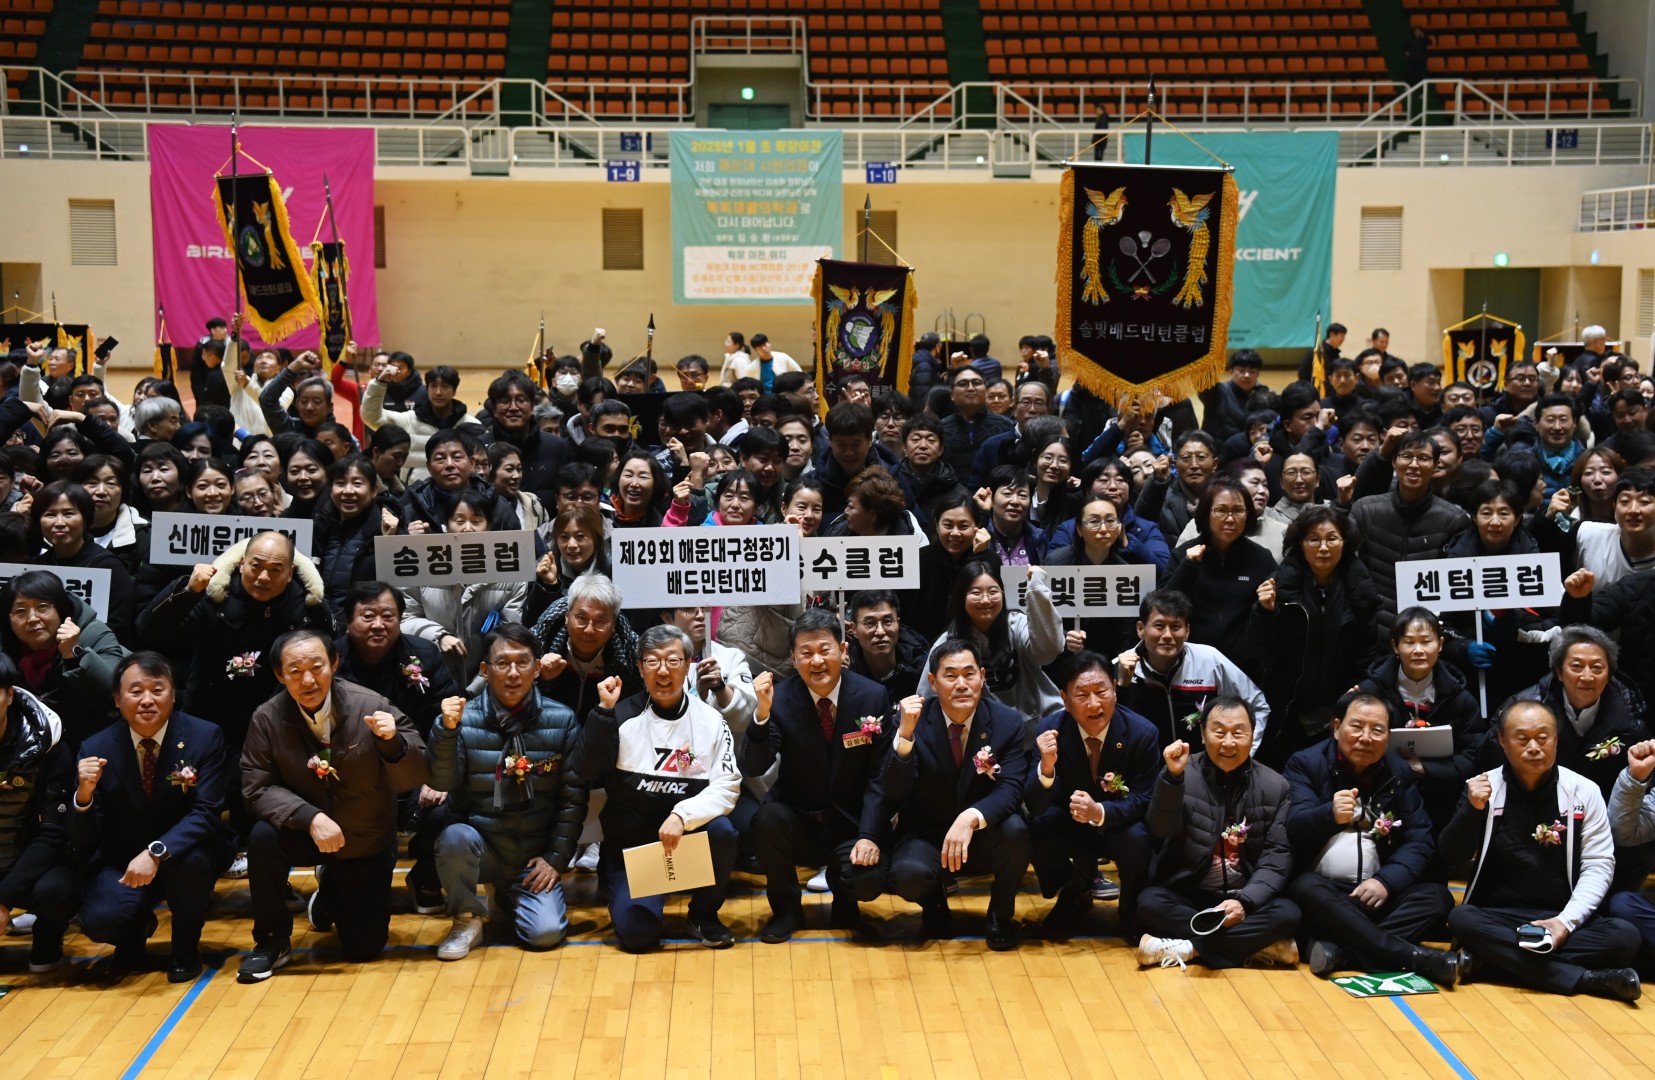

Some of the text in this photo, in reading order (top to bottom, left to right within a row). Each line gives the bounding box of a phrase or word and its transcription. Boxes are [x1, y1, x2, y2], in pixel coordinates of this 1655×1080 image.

[691, 140, 733, 154] 2025년
[869, 170, 895, 182] 1-10
[717, 217, 738, 228] 다시
[393, 541, 521, 577] 송정클럽
[619, 536, 790, 566] 제29회 해운대구청장기
[799, 546, 904, 580] 수클럽
[667, 568, 766, 595] 배드민턴대회
[1414, 564, 1545, 602] 센텀클럽
[636, 779, 689, 794] MIKAZ
[665, 857, 676, 881] MIKAZ
